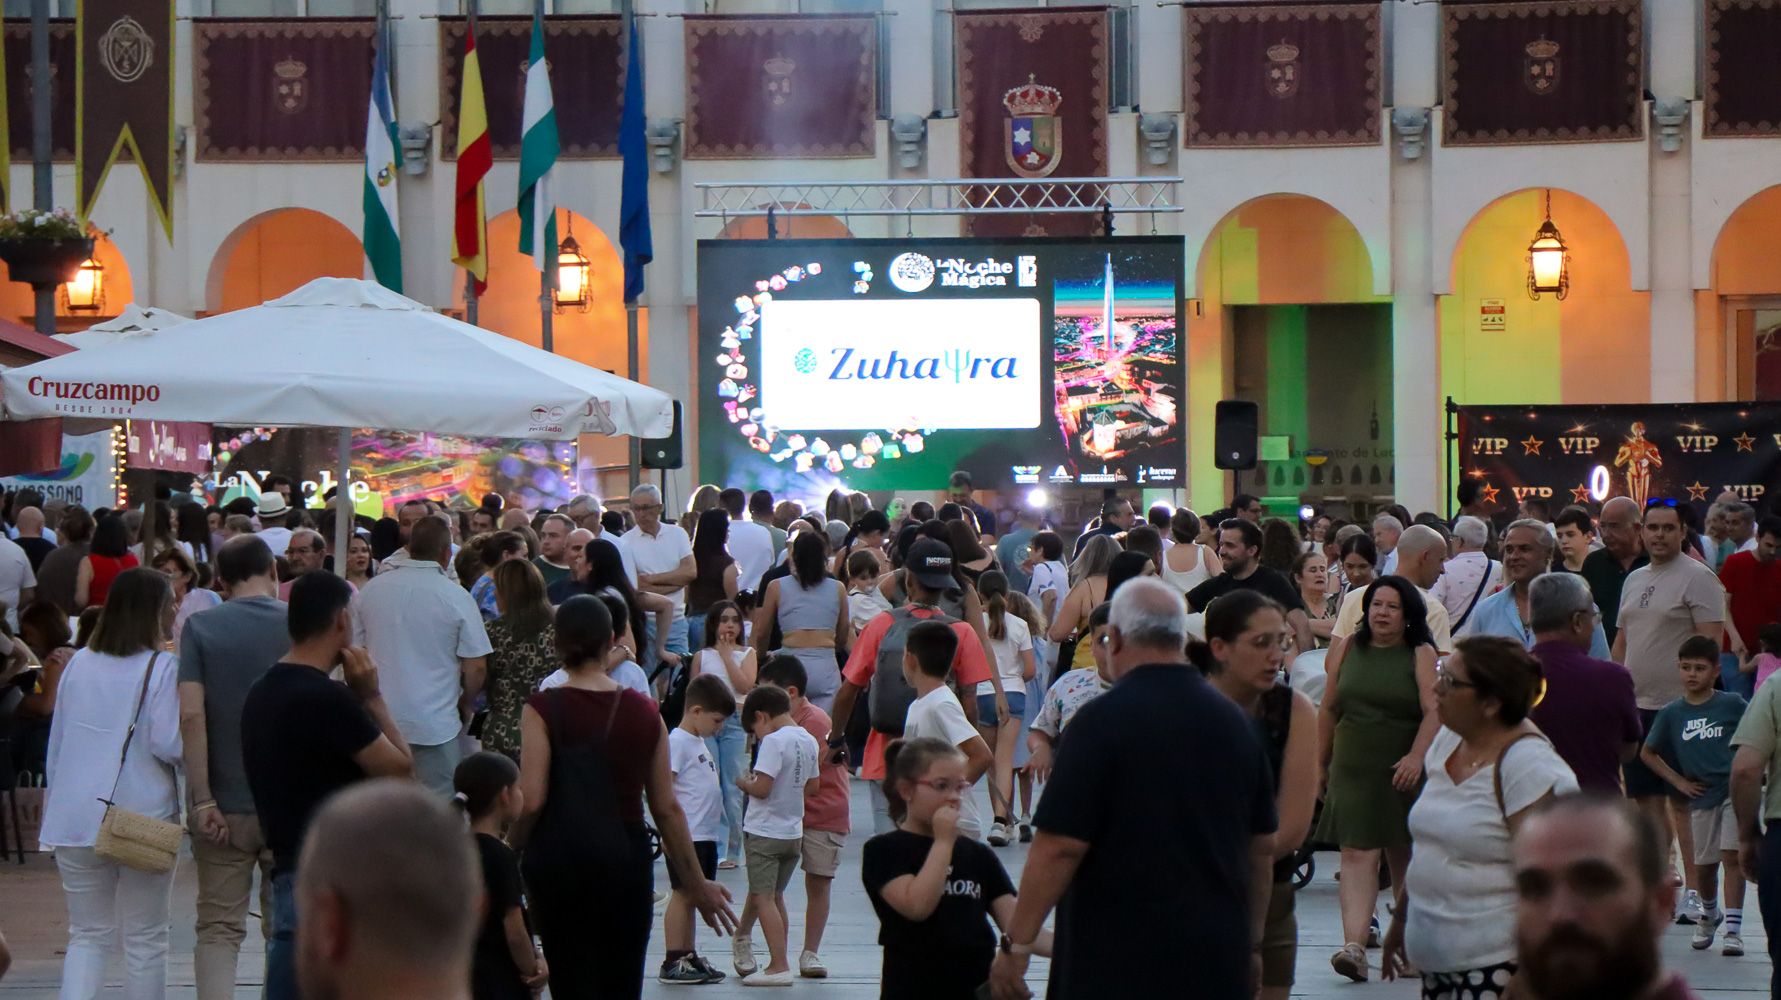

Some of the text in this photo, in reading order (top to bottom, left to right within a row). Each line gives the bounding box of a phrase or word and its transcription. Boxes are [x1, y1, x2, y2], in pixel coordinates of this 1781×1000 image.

[948, 258, 1013, 274] Noche
[941, 272, 1007, 288] Mágica
[28, 376, 160, 405] Cruzcampo
[56, 403, 93, 414] DESDE
[1473, 437, 1509, 455] VIP
[1559, 437, 1600, 454] VIP
[1676, 435, 1719, 453] VIP
[1512, 486, 1554, 503] VIP
[1686, 718, 1707, 731] JUST
[1699, 727, 1723, 740] DO IT
